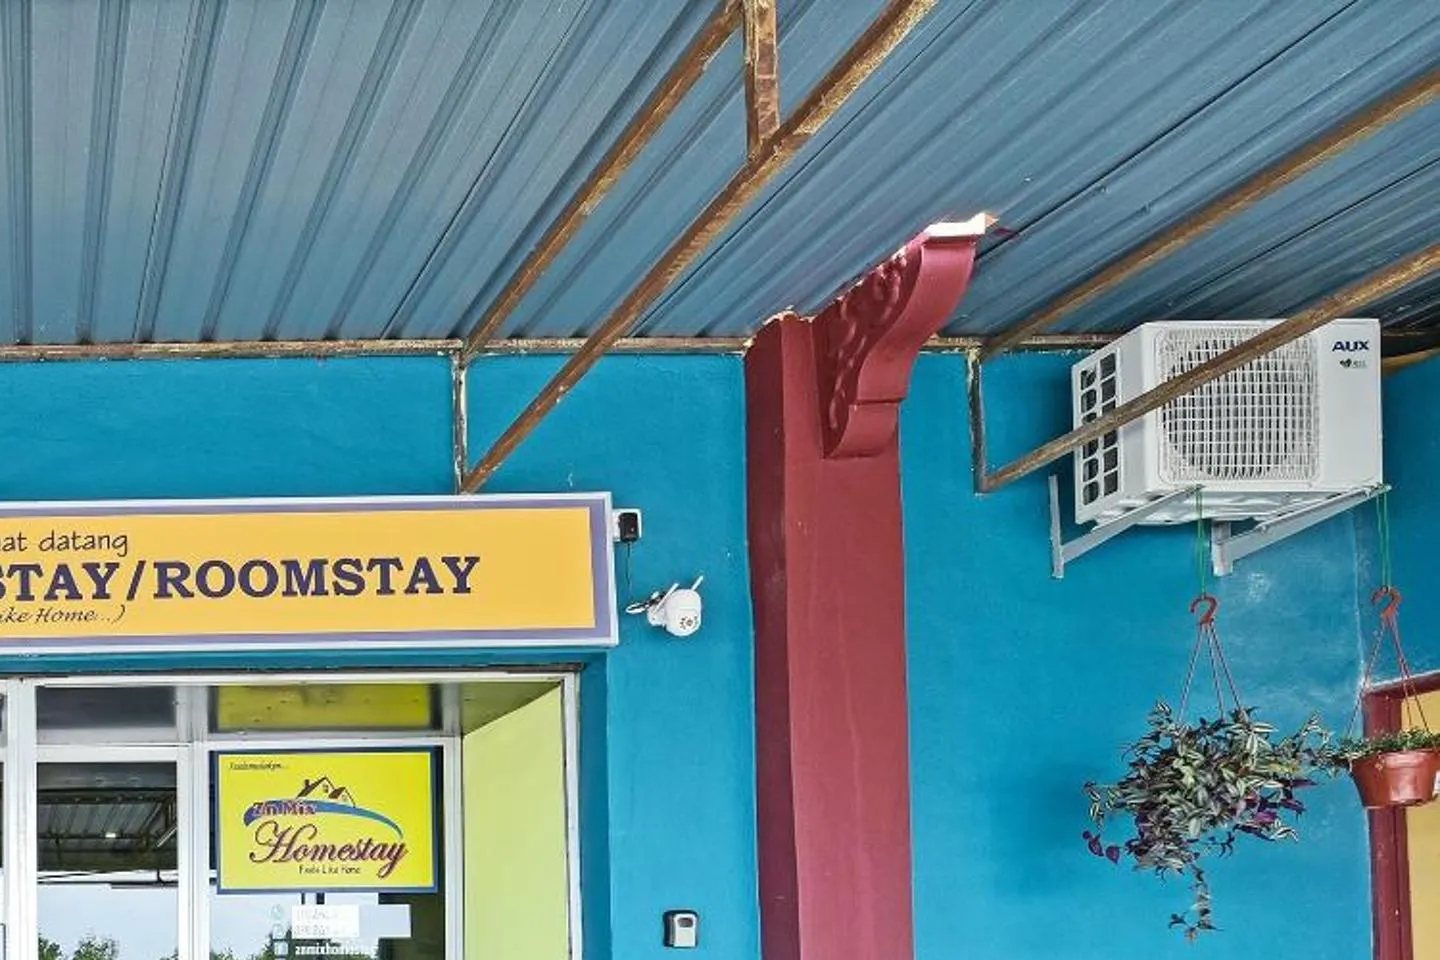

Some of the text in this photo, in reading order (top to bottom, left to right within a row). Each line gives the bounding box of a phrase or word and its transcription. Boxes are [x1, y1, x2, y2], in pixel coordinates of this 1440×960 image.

[1332, 340, 1369, 352] AUX
[38, 529, 128, 558] datang
[249, 819, 409, 879] Homestay
